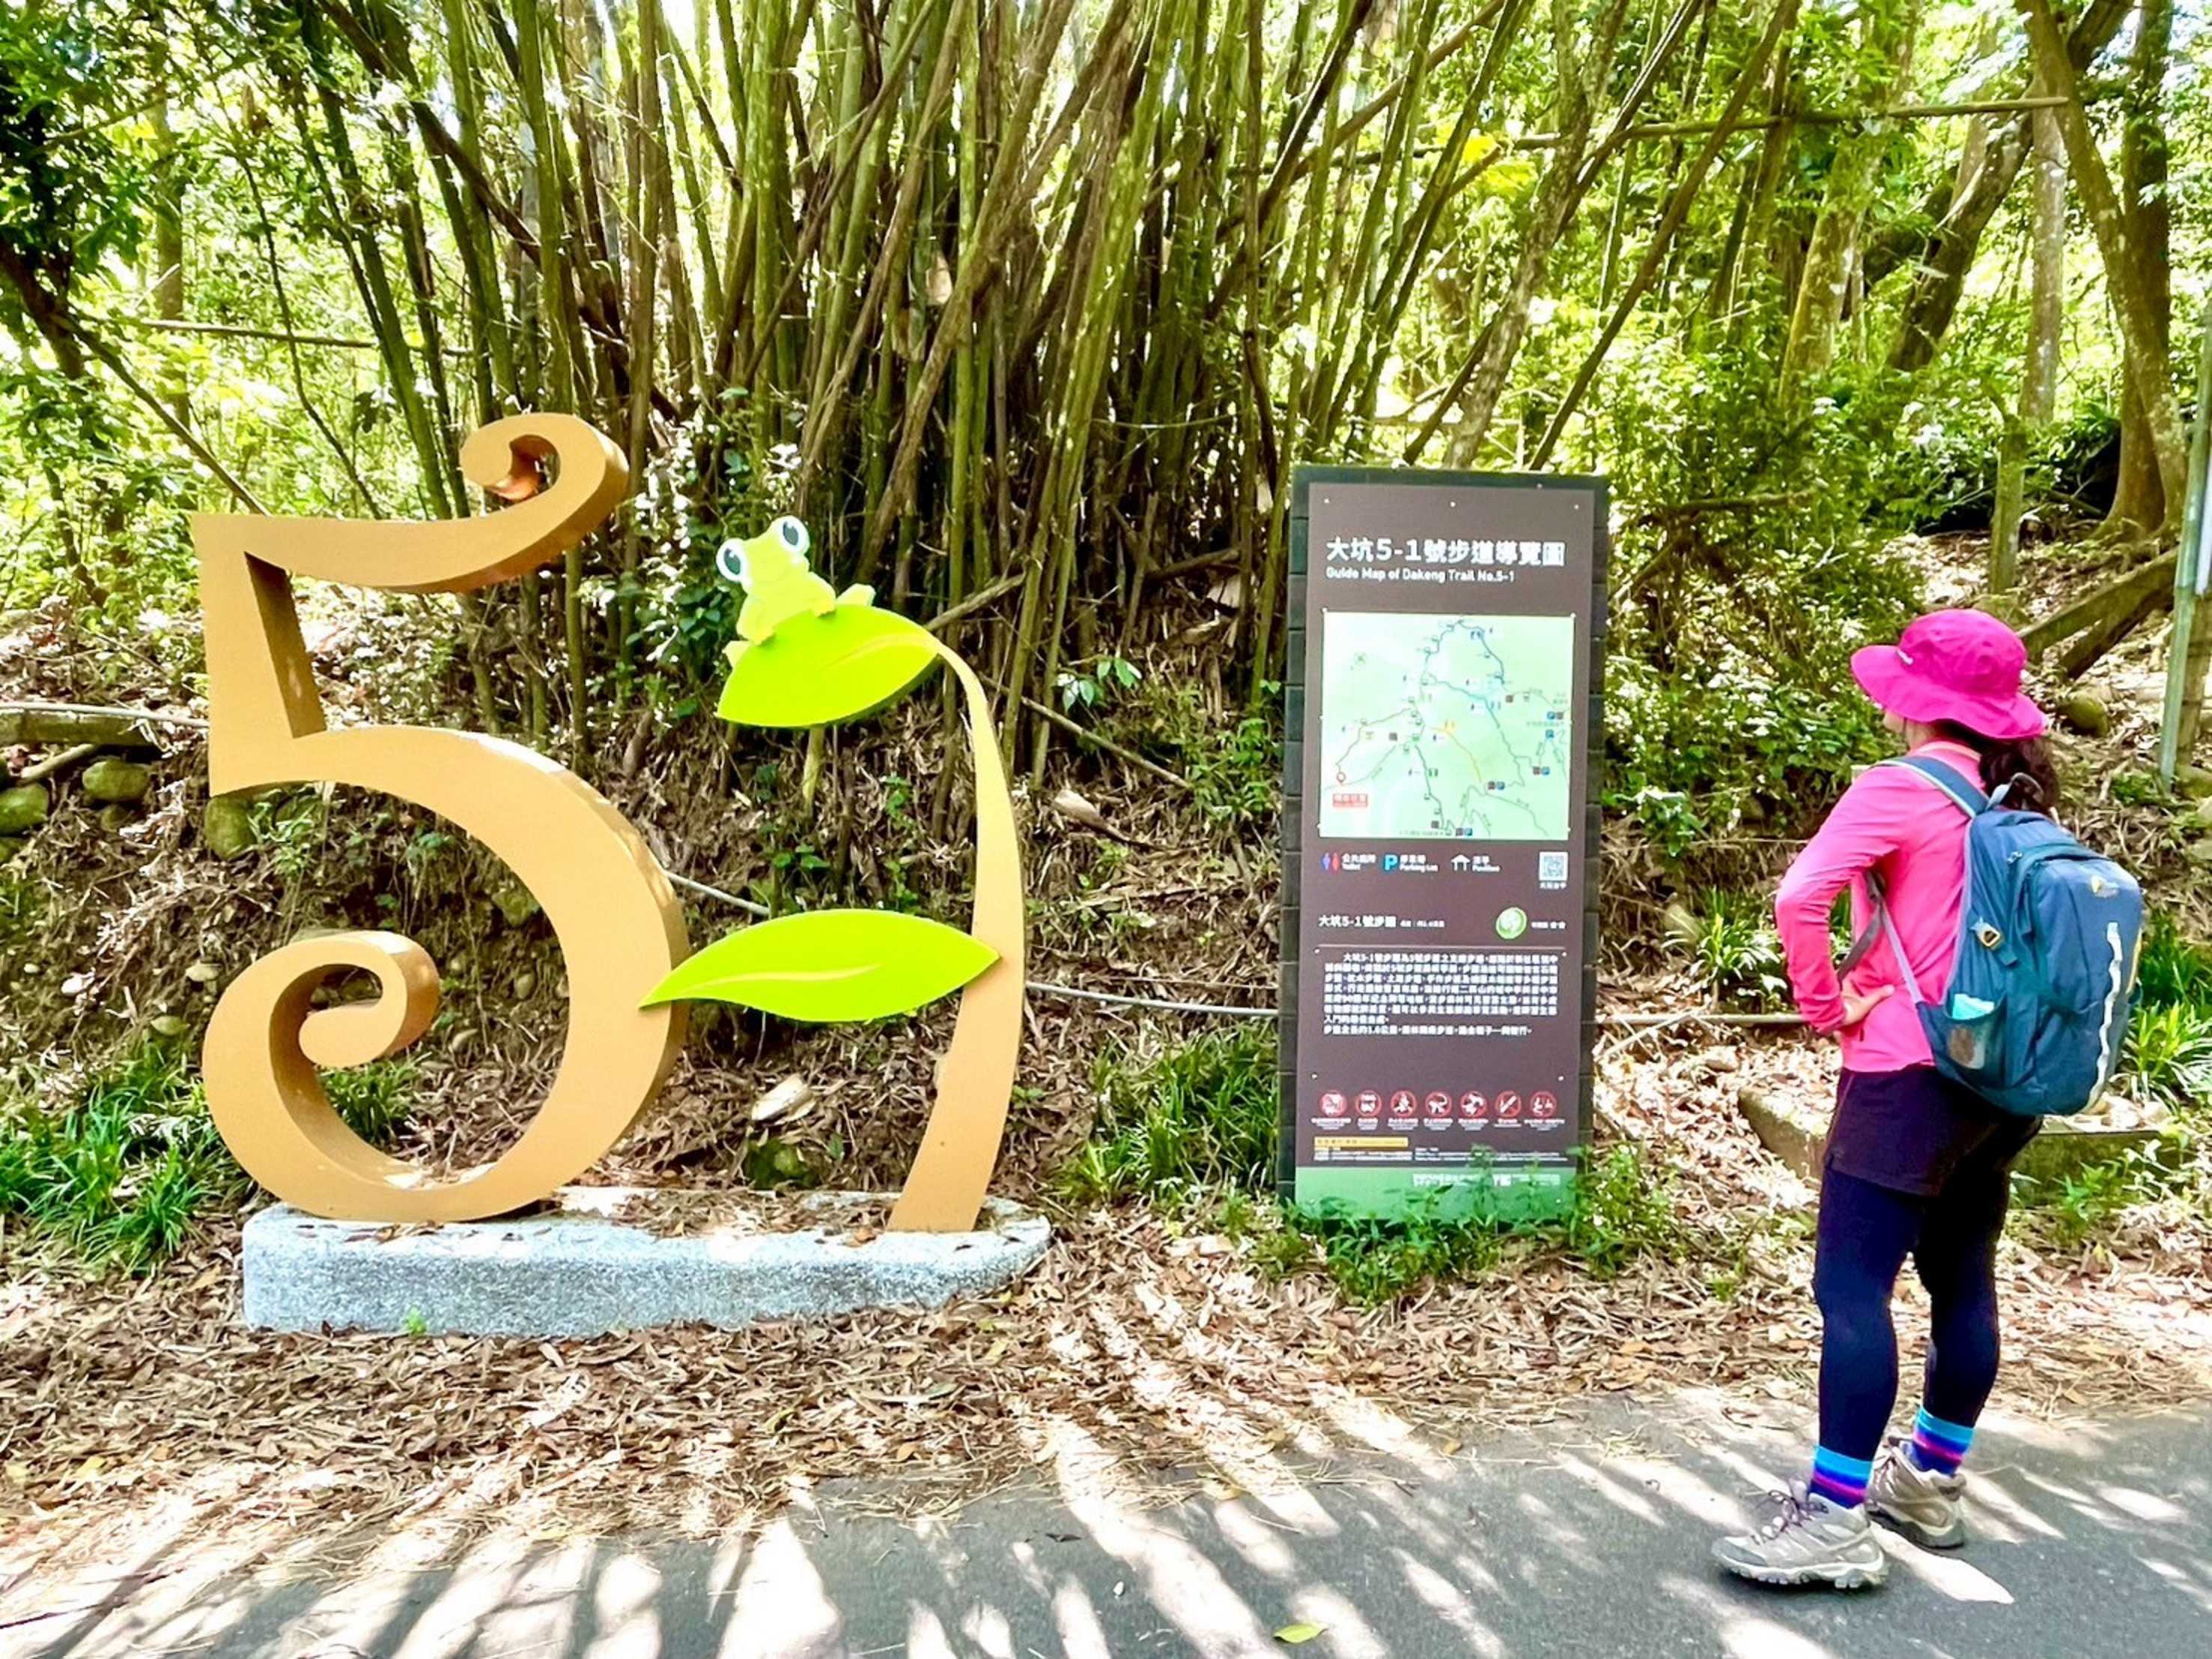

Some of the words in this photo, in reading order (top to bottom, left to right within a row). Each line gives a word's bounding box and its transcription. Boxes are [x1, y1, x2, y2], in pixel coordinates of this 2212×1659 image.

[1326, 537, 1566, 567] 大坑5-1號步道導覽圖
[1326, 566, 1359, 579] Guide
[1362, 567, 1385, 582] Map
[1388, 567, 1400, 579] of
[1403, 569, 1445, 582] Dakeng
[1448, 569, 1474, 582] Trail
[1477, 570, 1515, 582] No.5-1
